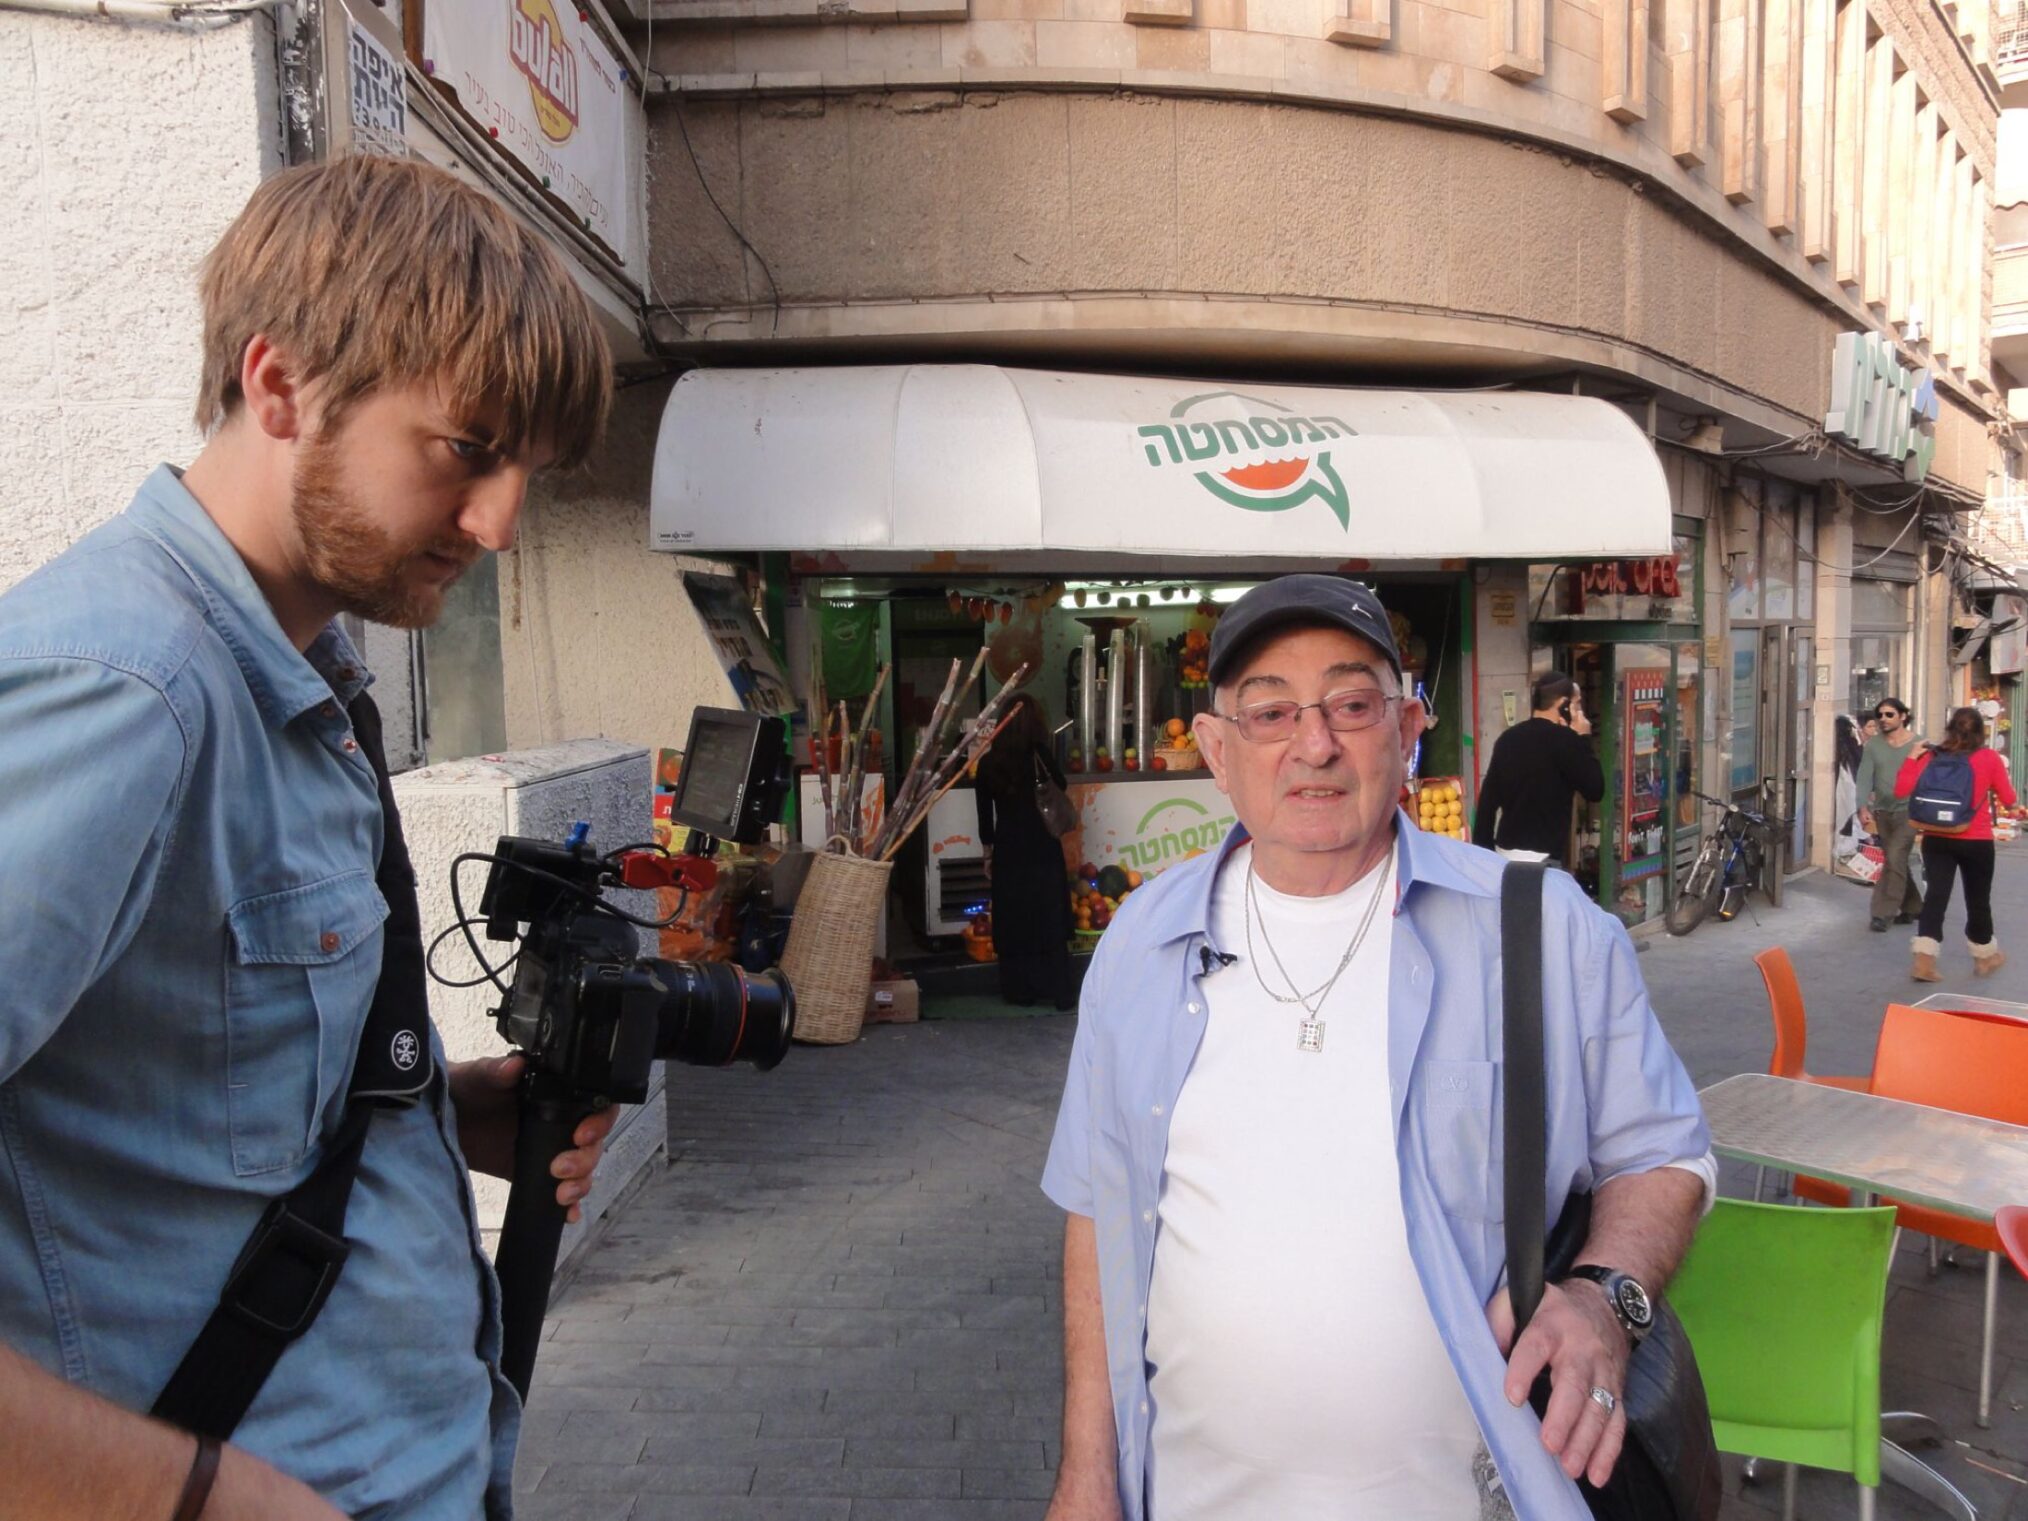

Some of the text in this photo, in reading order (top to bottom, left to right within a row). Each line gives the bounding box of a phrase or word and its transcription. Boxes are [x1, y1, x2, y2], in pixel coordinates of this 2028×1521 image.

[352, 31, 404, 101] איפה
[464, 70, 490, 115] בעיר
[493, 101, 517, 135] טוב
[1137, 415, 1359, 467] המסחטה
